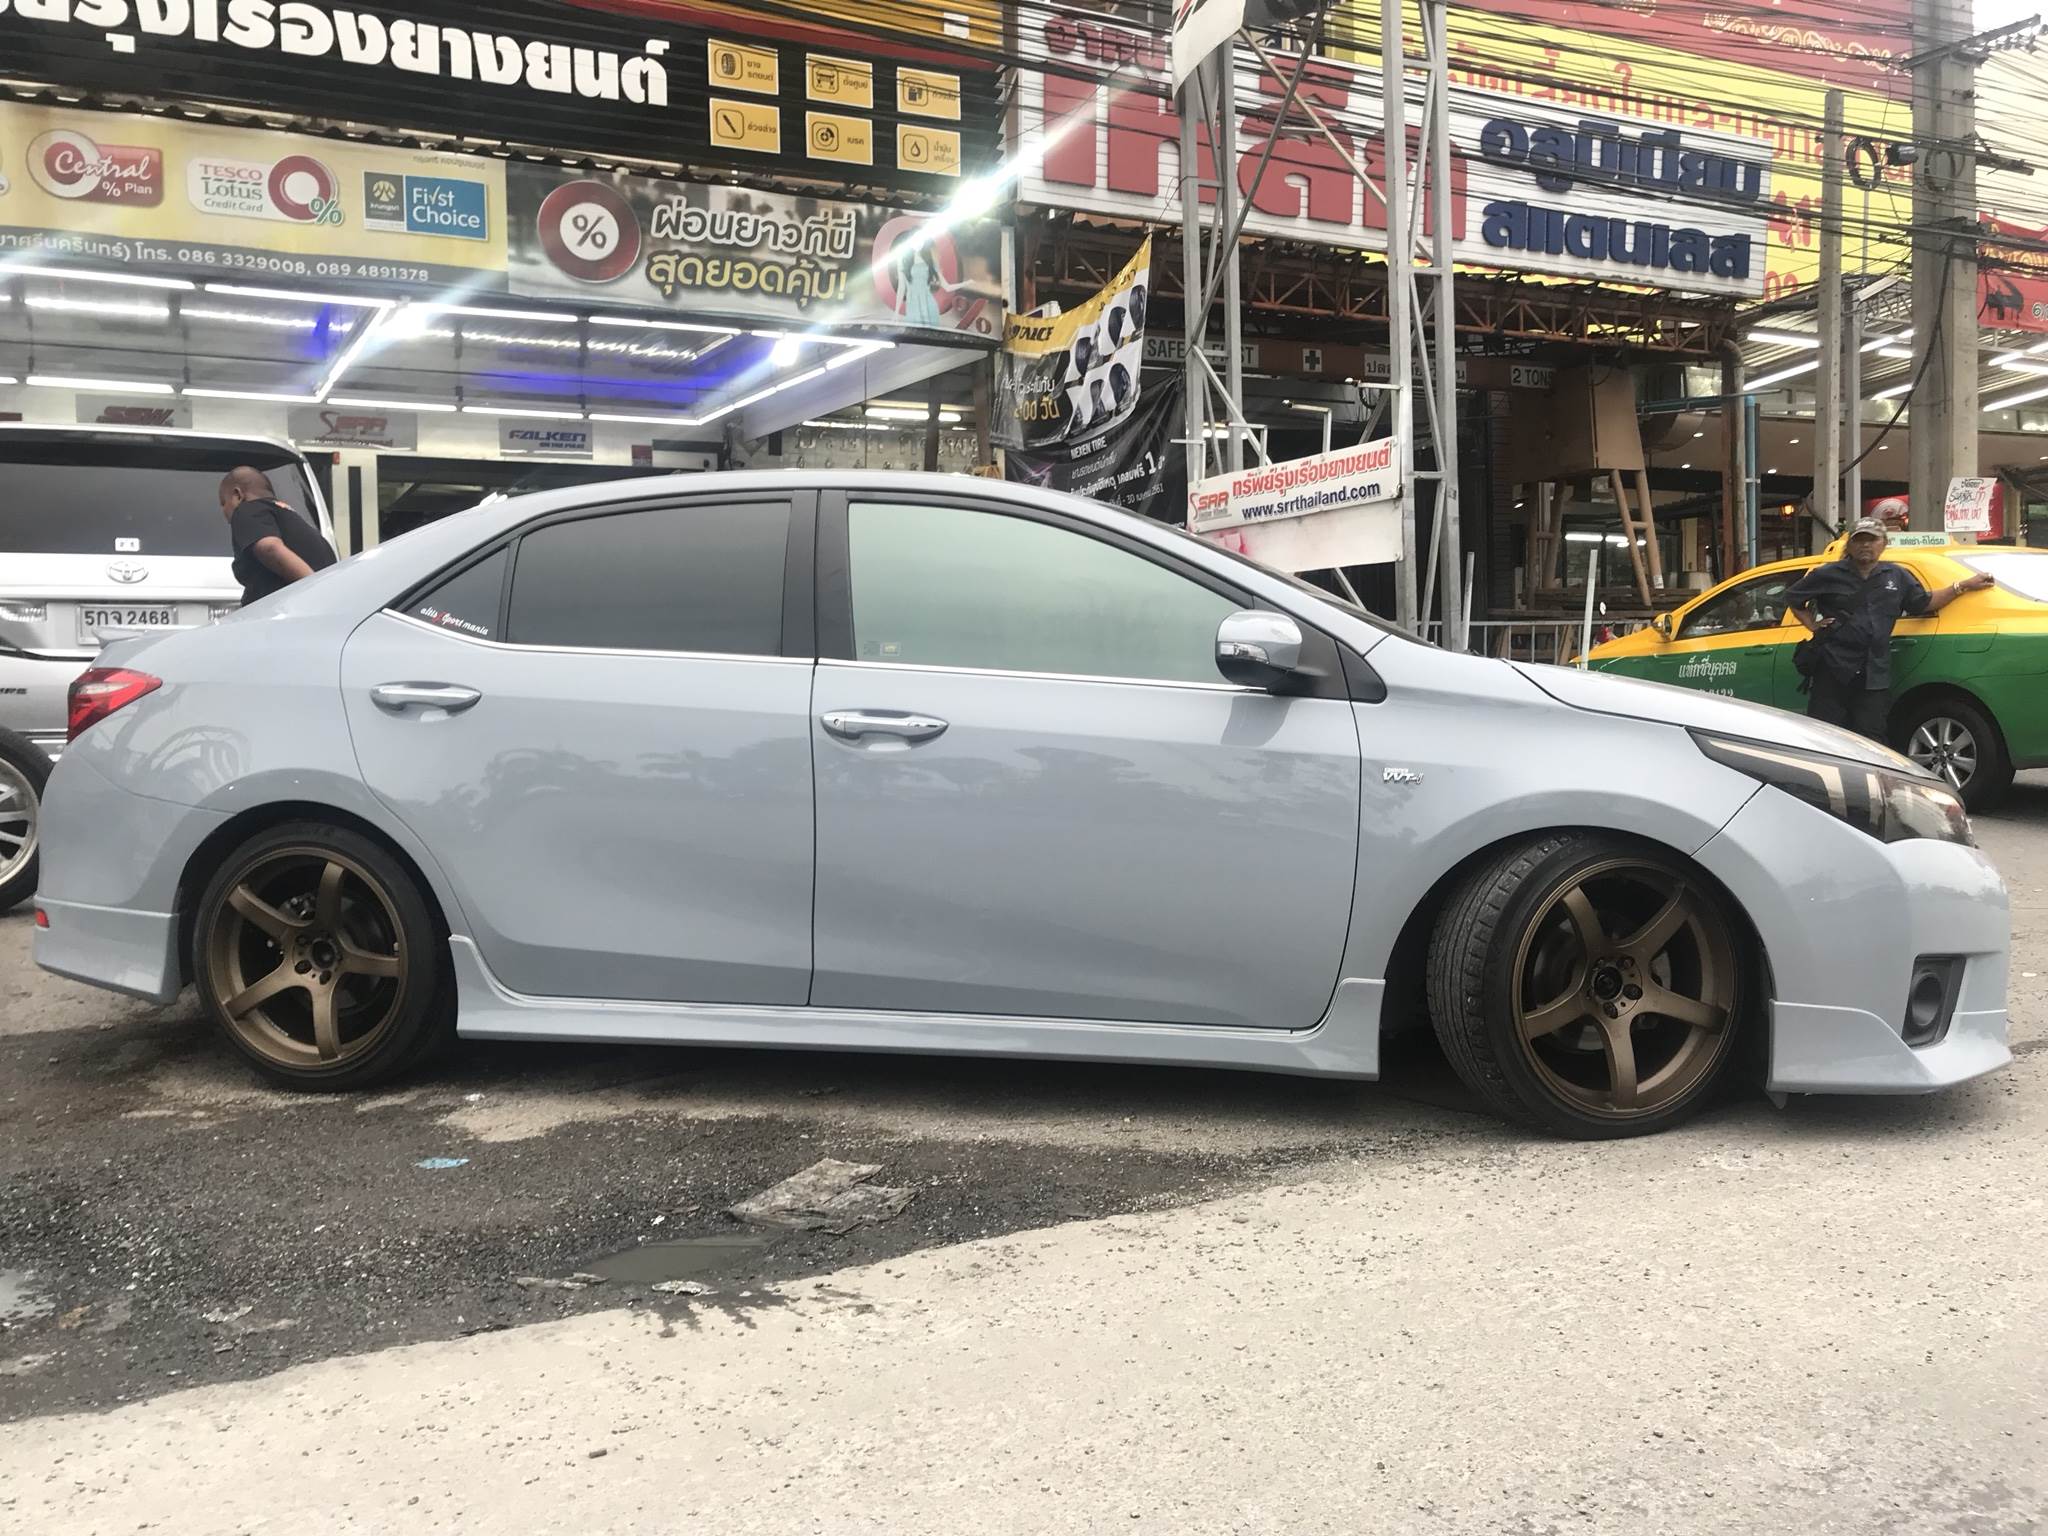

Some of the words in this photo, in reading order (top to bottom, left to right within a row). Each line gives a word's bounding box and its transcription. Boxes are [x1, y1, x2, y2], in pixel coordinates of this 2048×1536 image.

[54, 149, 152, 181] Central
[200, 163, 263, 181] TESCO
[124, 182, 153, 196] Plan
[204, 182, 263, 201] Lotus
[203, 197, 235, 210] Credit
[238, 201, 264, 213] Card
[412, 205, 480, 229] Choice
[1482, 200, 1751, 279] สแตนเลส
[178, 250, 216, 265] 086
[222, 252, 310, 275] 3329008,
[316, 263, 352, 279] 089
[356, 265, 430, 283] 4891378
[649, 253, 849, 307] สุดยอดคุ้ม!
[1512, 368, 1521, 382] 2
[508, 429, 587, 442] FALKEN
[1242, 482, 1381, 521] www.srrthailand.com
[84, 610, 122, 626] 5กจ
[127, 610, 169, 625] 2468
